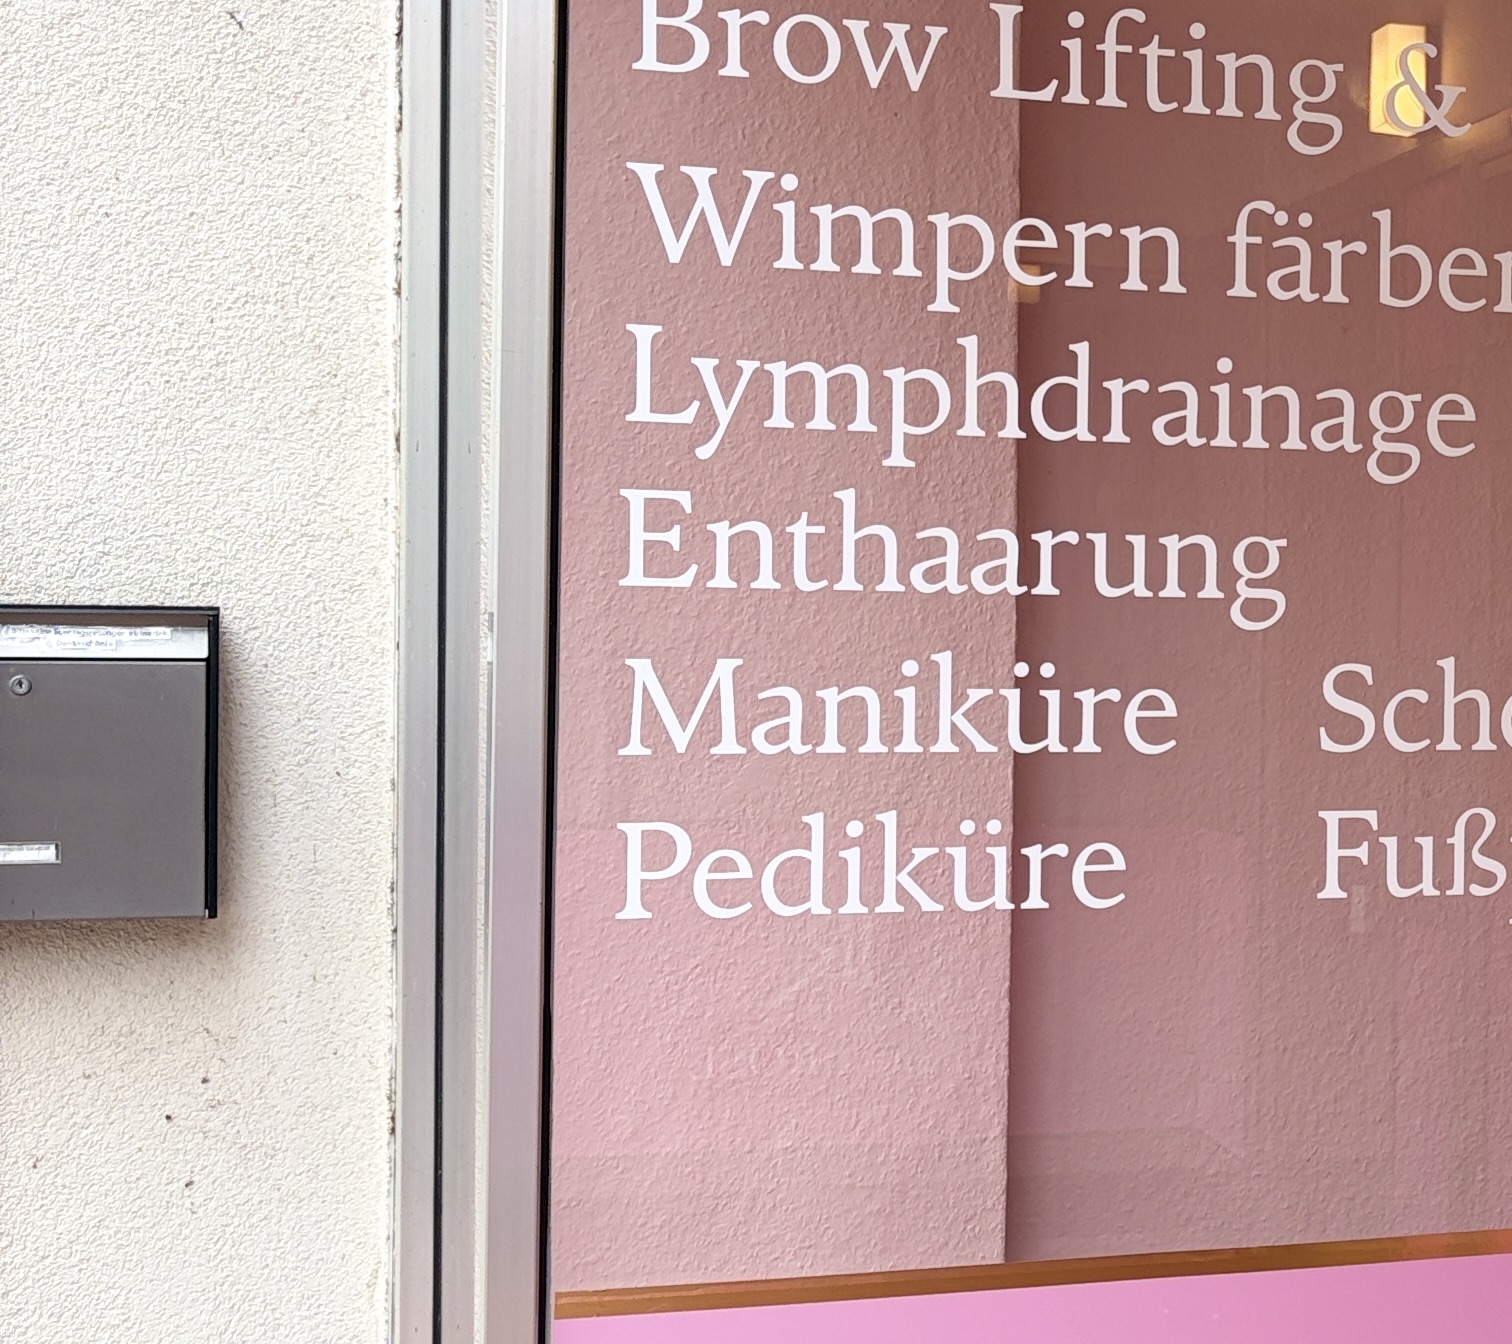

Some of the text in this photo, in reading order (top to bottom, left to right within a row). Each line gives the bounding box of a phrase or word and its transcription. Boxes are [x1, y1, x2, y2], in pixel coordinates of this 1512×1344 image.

[989, 3, 1344, 156] Lifting
[1384, 42, 1472, 138] &
[626, 161, 1188, 314] Wimpern
[625, 323, 1477, 485] Lymphdrainage
[618, 487, 1289, 631] Enthaarung
[618, 650, 1178, 757] Maniküre
[615, 810, 1127, 921] Pediküre
